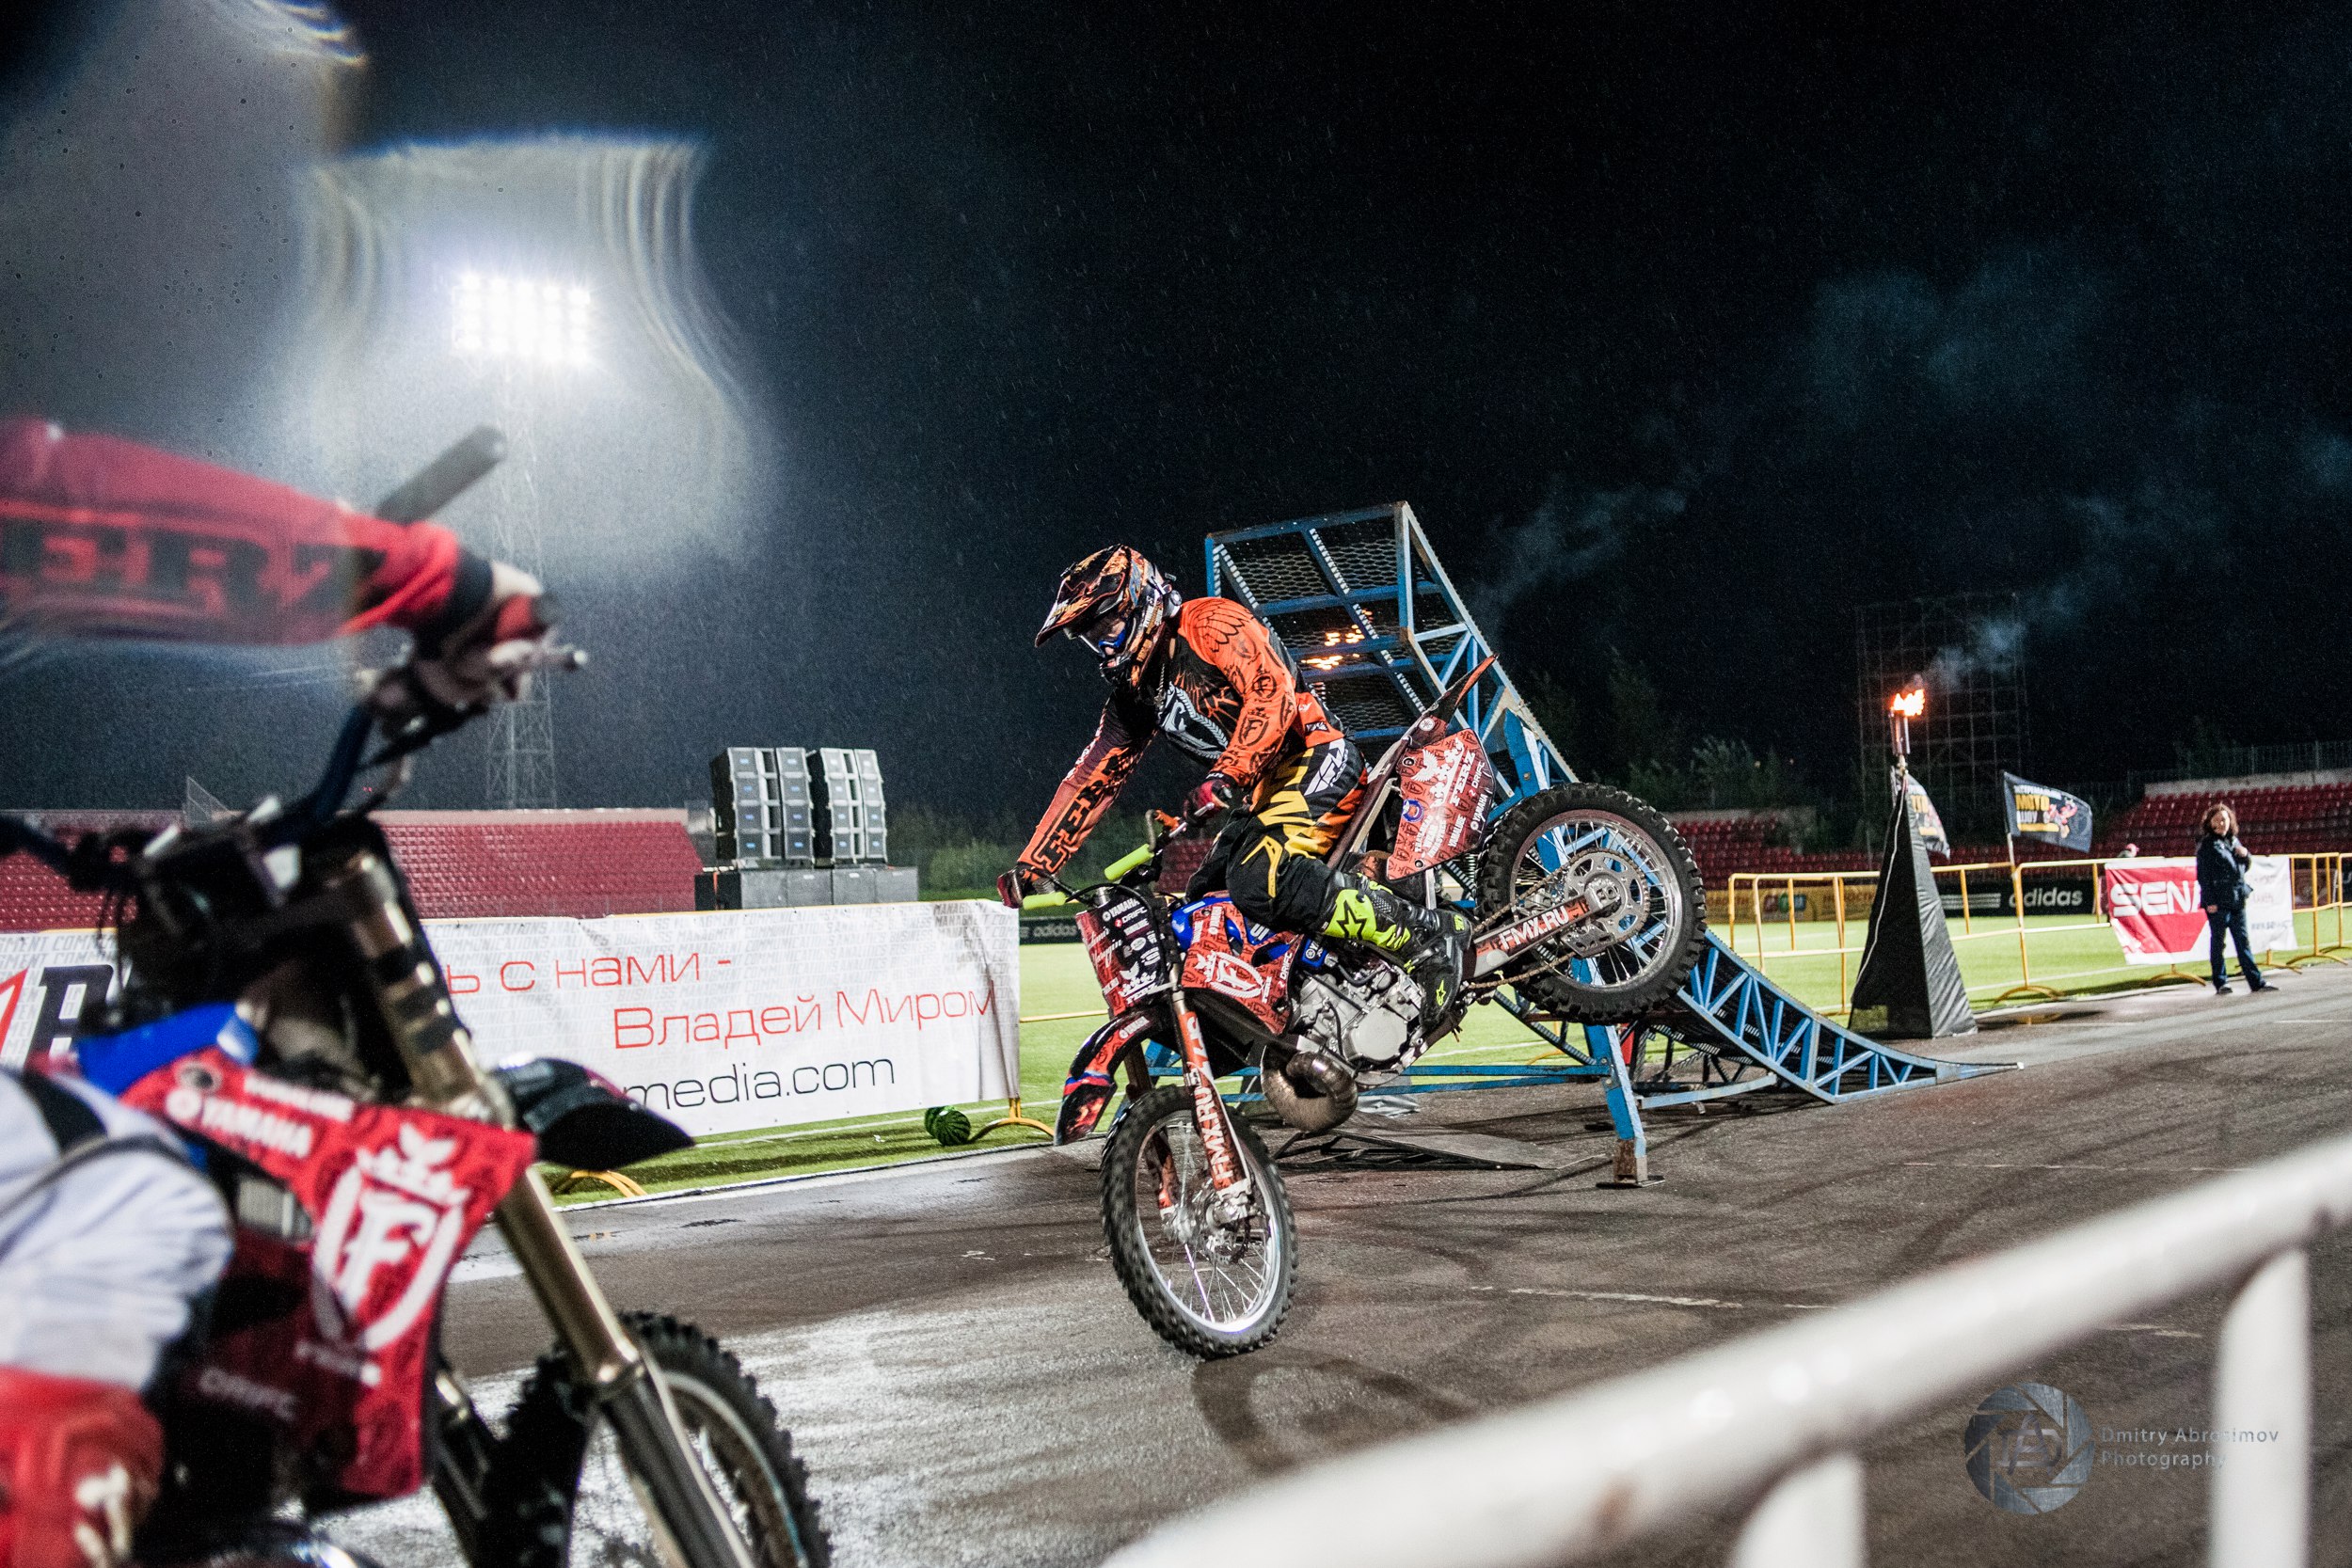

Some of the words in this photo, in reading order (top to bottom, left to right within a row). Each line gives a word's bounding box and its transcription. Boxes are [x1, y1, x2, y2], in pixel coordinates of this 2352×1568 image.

[1450, 750, 1476, 807] FERZ
[1474, 793, 1489, 823] YAMAHA
[1109, 897, 1141, 918] YAMAHA
[1499, 905, 1570, 950] FMX.RU
[555, 952, 700, 989] нами
[613, 994, 821, 1050] Владей
[836, 979, 996, 1031] Миром
[1193, 1085, 1234, 1181] FMX.RU
